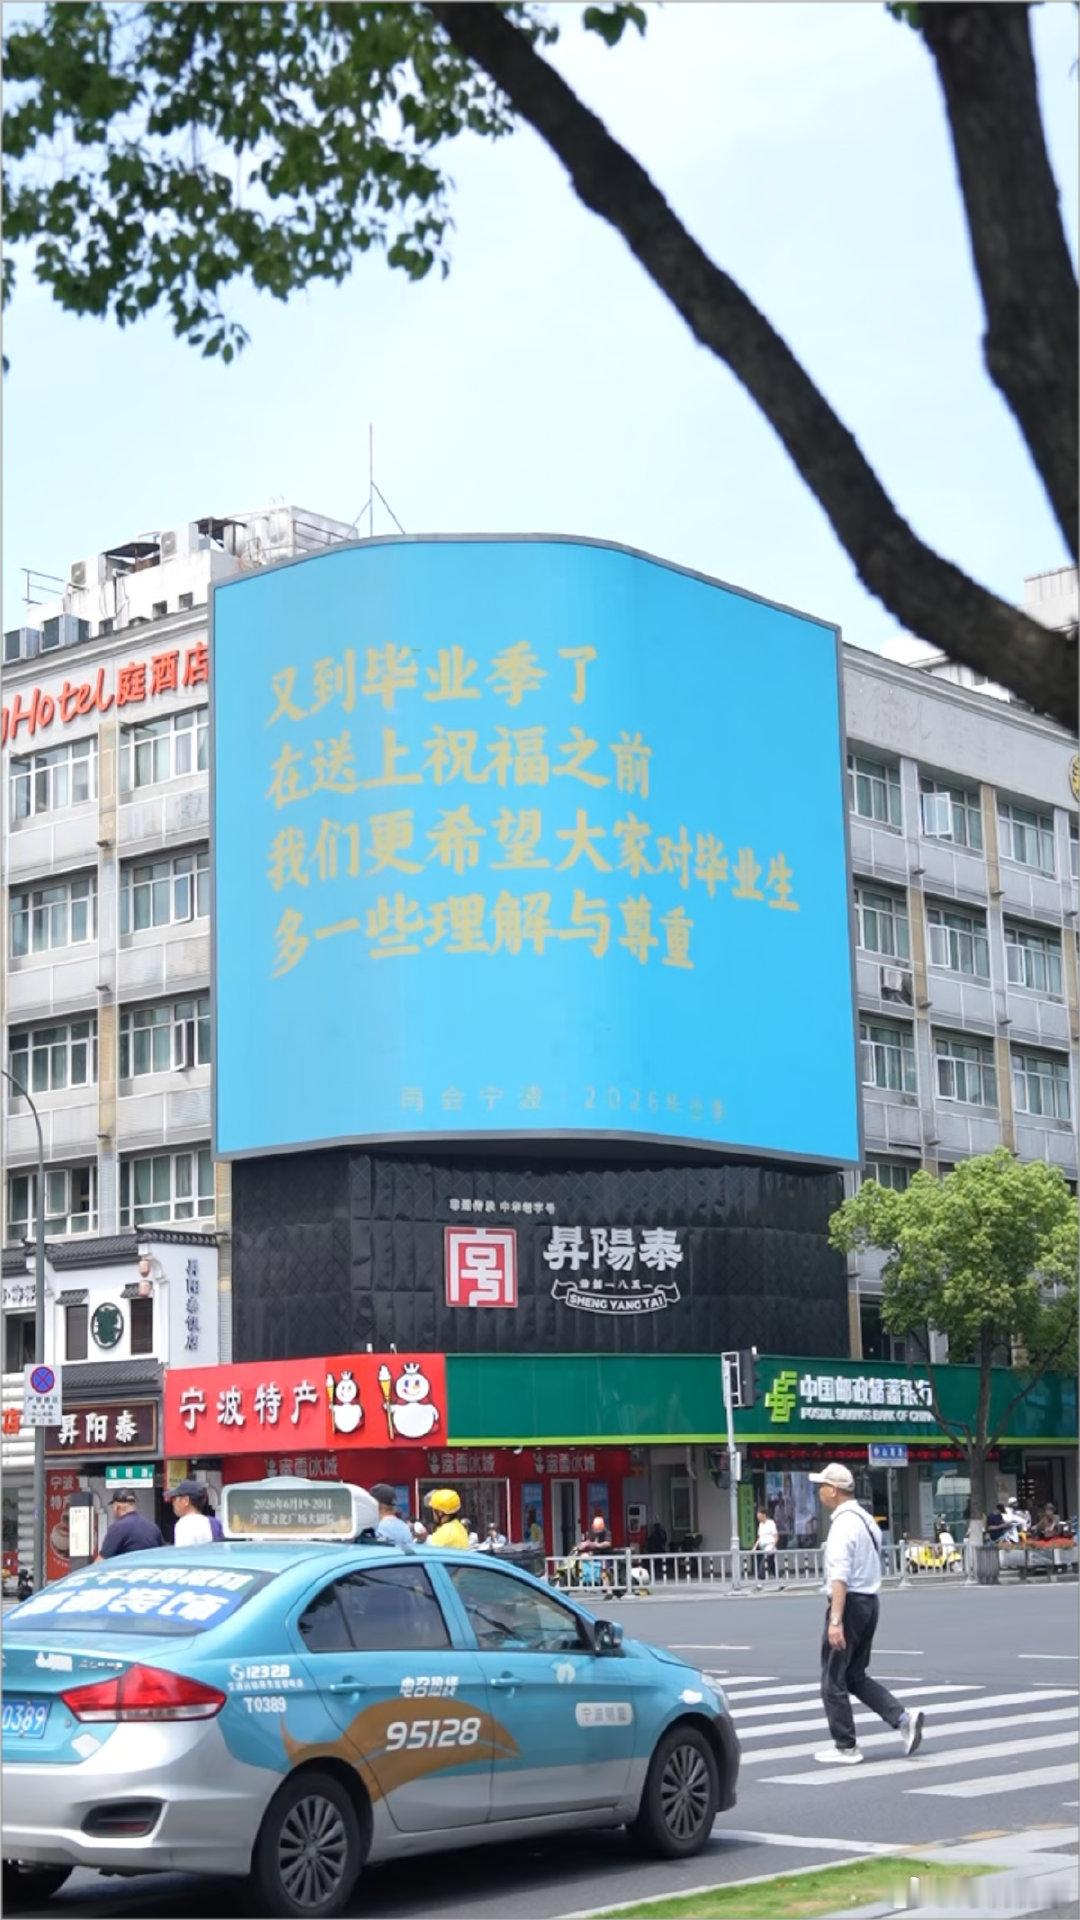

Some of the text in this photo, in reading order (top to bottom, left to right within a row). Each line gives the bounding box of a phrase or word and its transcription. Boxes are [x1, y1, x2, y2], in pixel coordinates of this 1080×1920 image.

[117, 642, 208, 706] 庭酒店
[266, 641, 598, 728] 又到毕业季了
[265, 725, 653, 810] 在送上祝福之前
[265, 803, 800, 912] 我们更希望大家对毕业生
[271, 889, 695, 979] 多一些理解与尊重
[543, 1226, 683, 1271] 昇陽泰
[569, 1293, 664, 1311] SHENG YANG TAI
[178, 1379, 318, 1431] 宁波特产
[800, 1374, 933, 1406] 中国邮政储蓄银行
[58, 1410, 138, 1444] 昇阳泰
[246, 1664, 290, 1679] 12328
[243, 1696, 287, 1713] T0389
[386, 1716, 481, 1751] 95128
